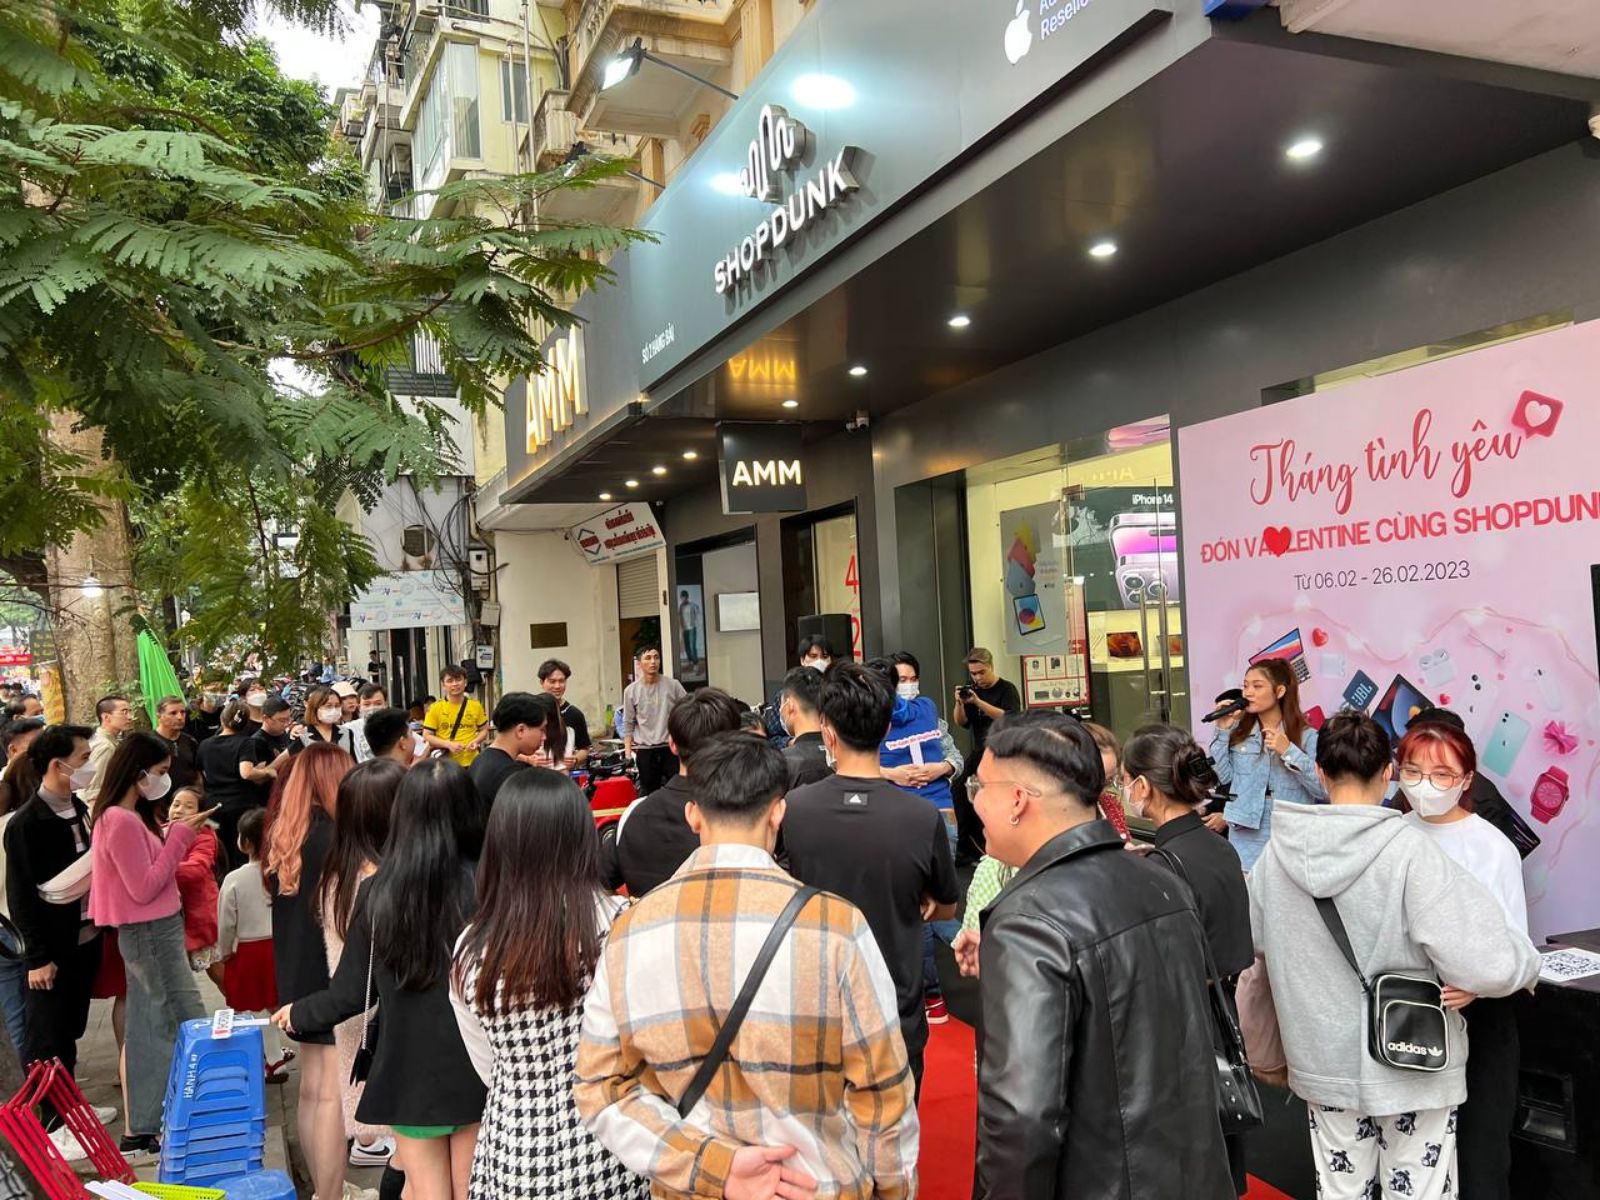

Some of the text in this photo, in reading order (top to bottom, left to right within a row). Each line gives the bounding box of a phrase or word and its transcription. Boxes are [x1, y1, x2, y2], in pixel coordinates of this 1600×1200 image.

[714, 145, 853, 294] SHOPDUNK
[525, 323, 588, 454] AMM
[732, 459, 802, 486] AMM
[1249, 408, 1522, 515] Tháng tình yêu
[1131, 493, 1175, 504] iPhone 14
[1200, 536, 1240, 563] ĐÓN
[1375, 511, 1447, 543] CÙNG
[1453, 491, 1600, 534] SHOPDUN
[1294, 573, 1312, 590] Từ
[1314, 569, 1358, 589] 06.02
[1372, 560, 1472, 585] 26.02.2023
[1353, 683, 1374, 706] JBL
[1387, 1042, 1427, 1056] adidas
